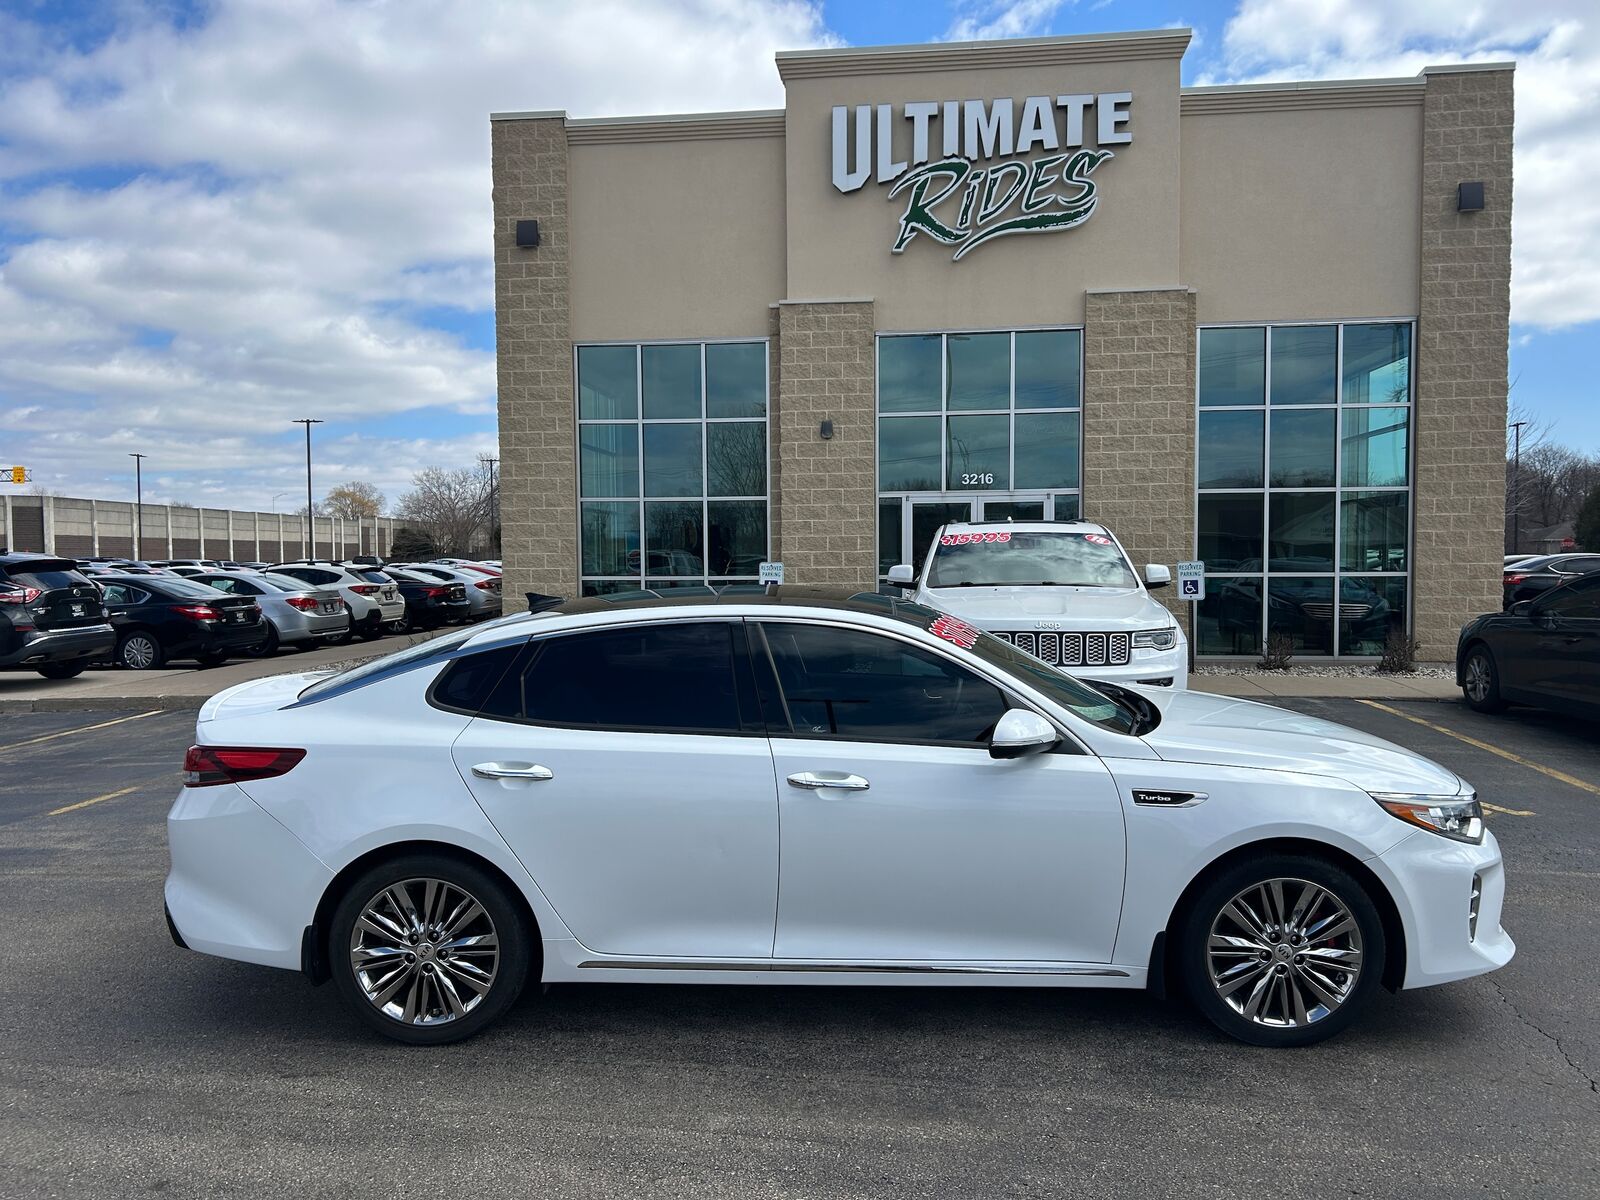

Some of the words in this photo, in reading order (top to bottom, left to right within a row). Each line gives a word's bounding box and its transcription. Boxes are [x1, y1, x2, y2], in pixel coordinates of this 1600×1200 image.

[832, 91, 1132, 193] ULTIMATE
[961, 473, 994, 485] 3216
[941, 532, 1011, 545] $15995
[1034, 620, 1061, 630] Jeep
[1138, 793, 1171, 801] Turbo
[419, 946, 431, 959] KIA
